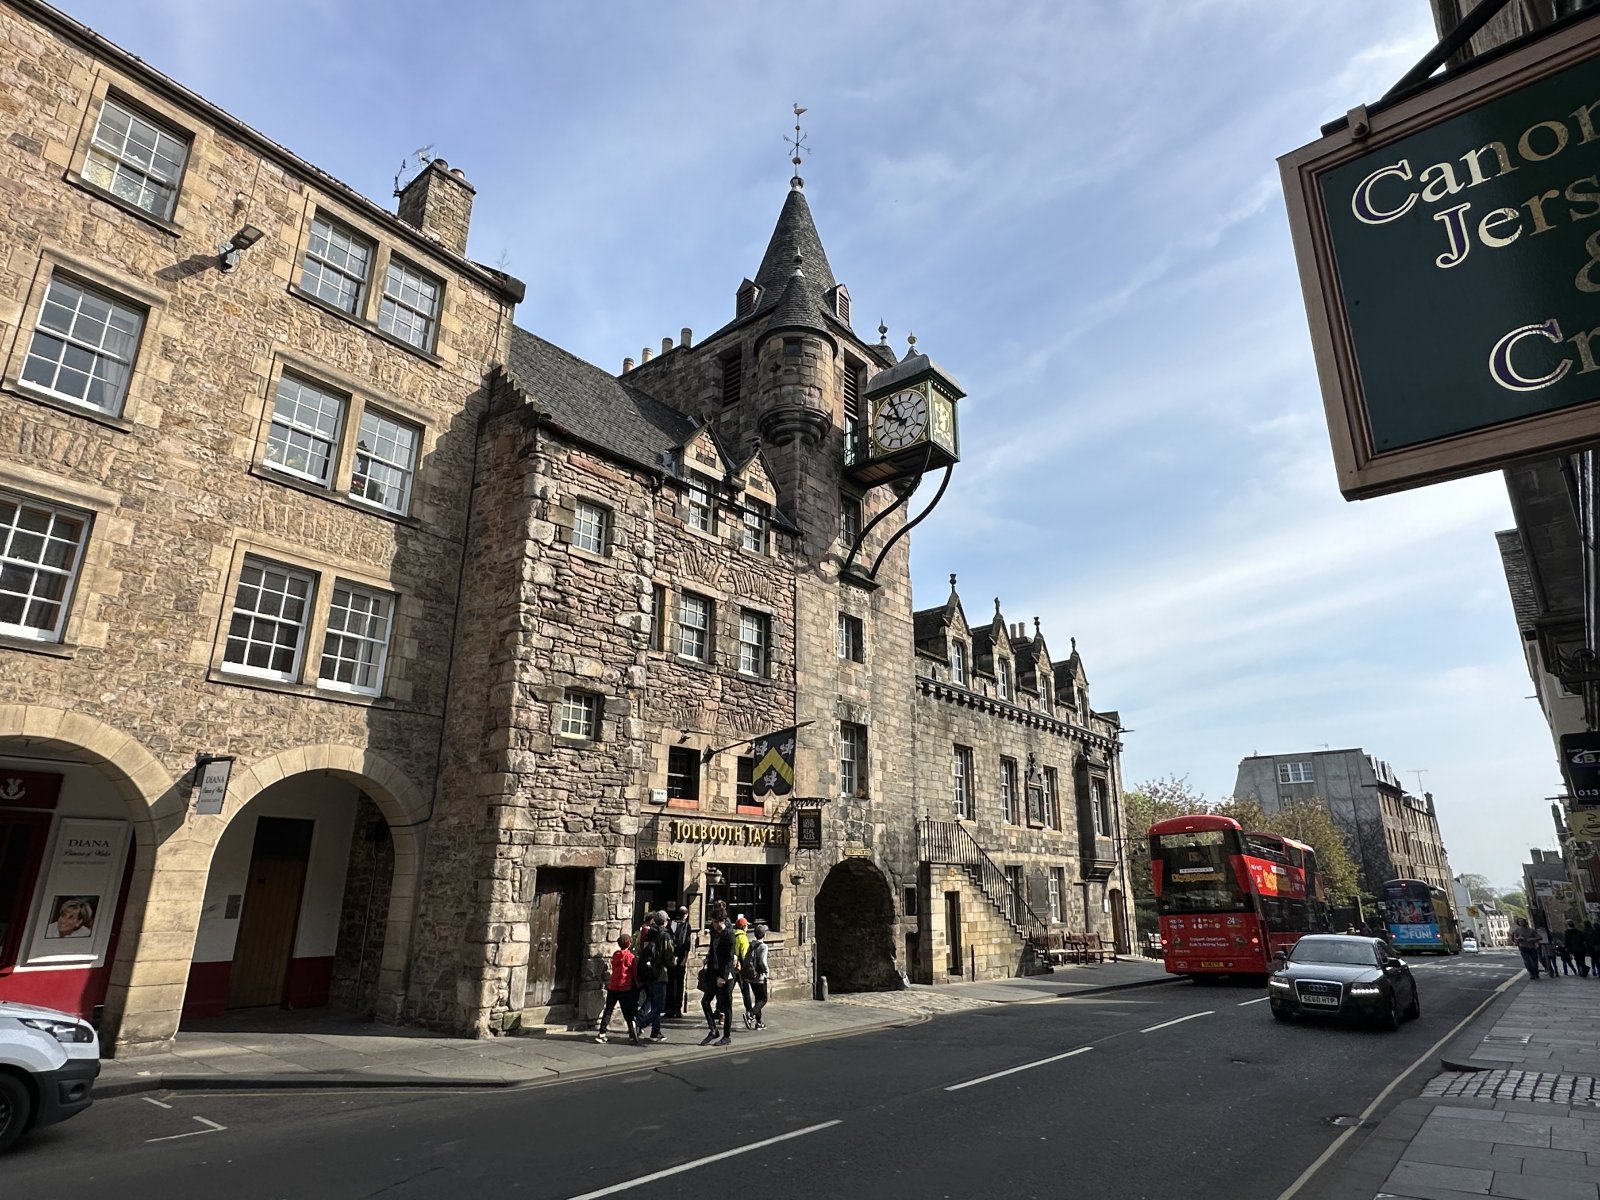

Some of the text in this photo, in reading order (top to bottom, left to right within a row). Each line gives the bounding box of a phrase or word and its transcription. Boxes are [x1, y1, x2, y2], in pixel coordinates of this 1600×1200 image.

[1433, 174, 1600, 269] Jers
[205, 775, 225, 784] DIANA
[674, 819, 743, 841] TOLBOOTH
[69, 839, 110, 847] DIANA
[666, 846, 683, 861] 1820
[1226, 916, 1235, 925] 24
[1409, 930, 1433, 939] FUN!
